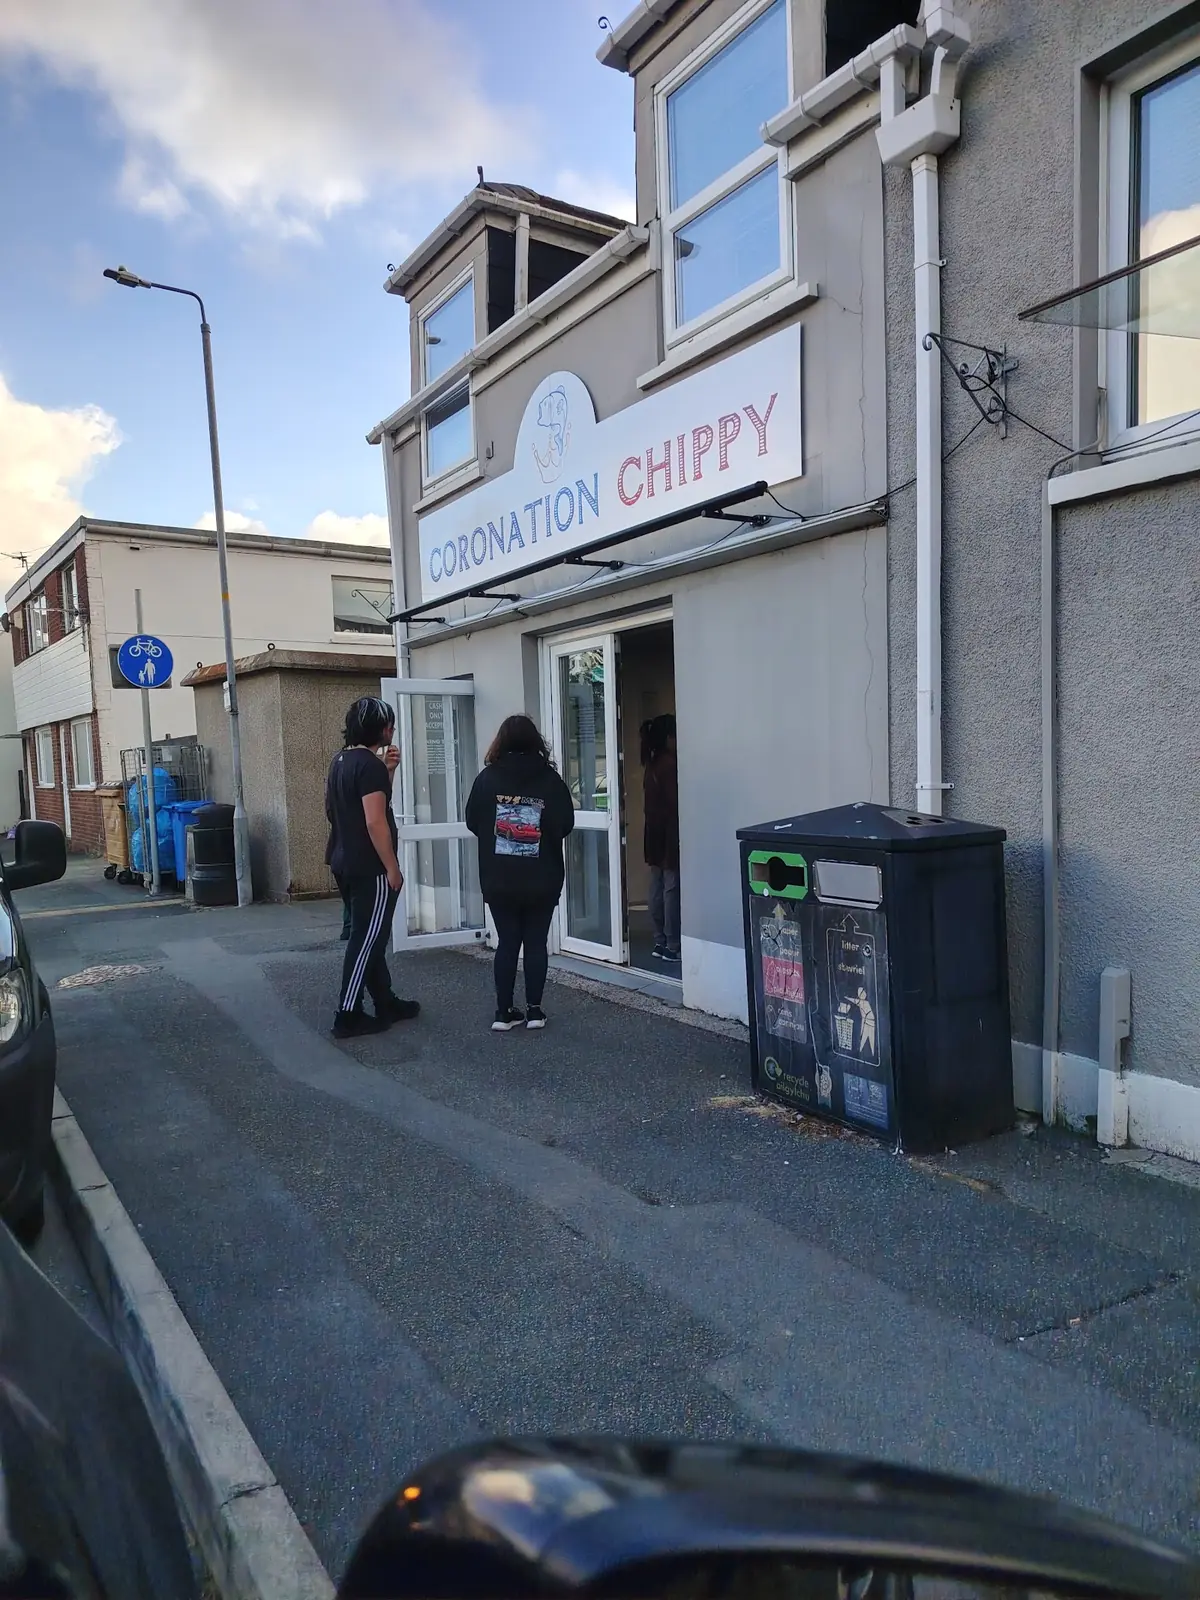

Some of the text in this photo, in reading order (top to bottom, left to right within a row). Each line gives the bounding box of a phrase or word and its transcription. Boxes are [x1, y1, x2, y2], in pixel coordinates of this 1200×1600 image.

[429, 392, 779, 583] CORONATION CHIPPY
[428, 702, 444, 710] CASH
[429, 711, 444, 720] ONLY
[841, 939, 860, 951] litter
[783, 1072, 809, 1088] recycle
[776, 1081, 810, 1101] ailgylchu
